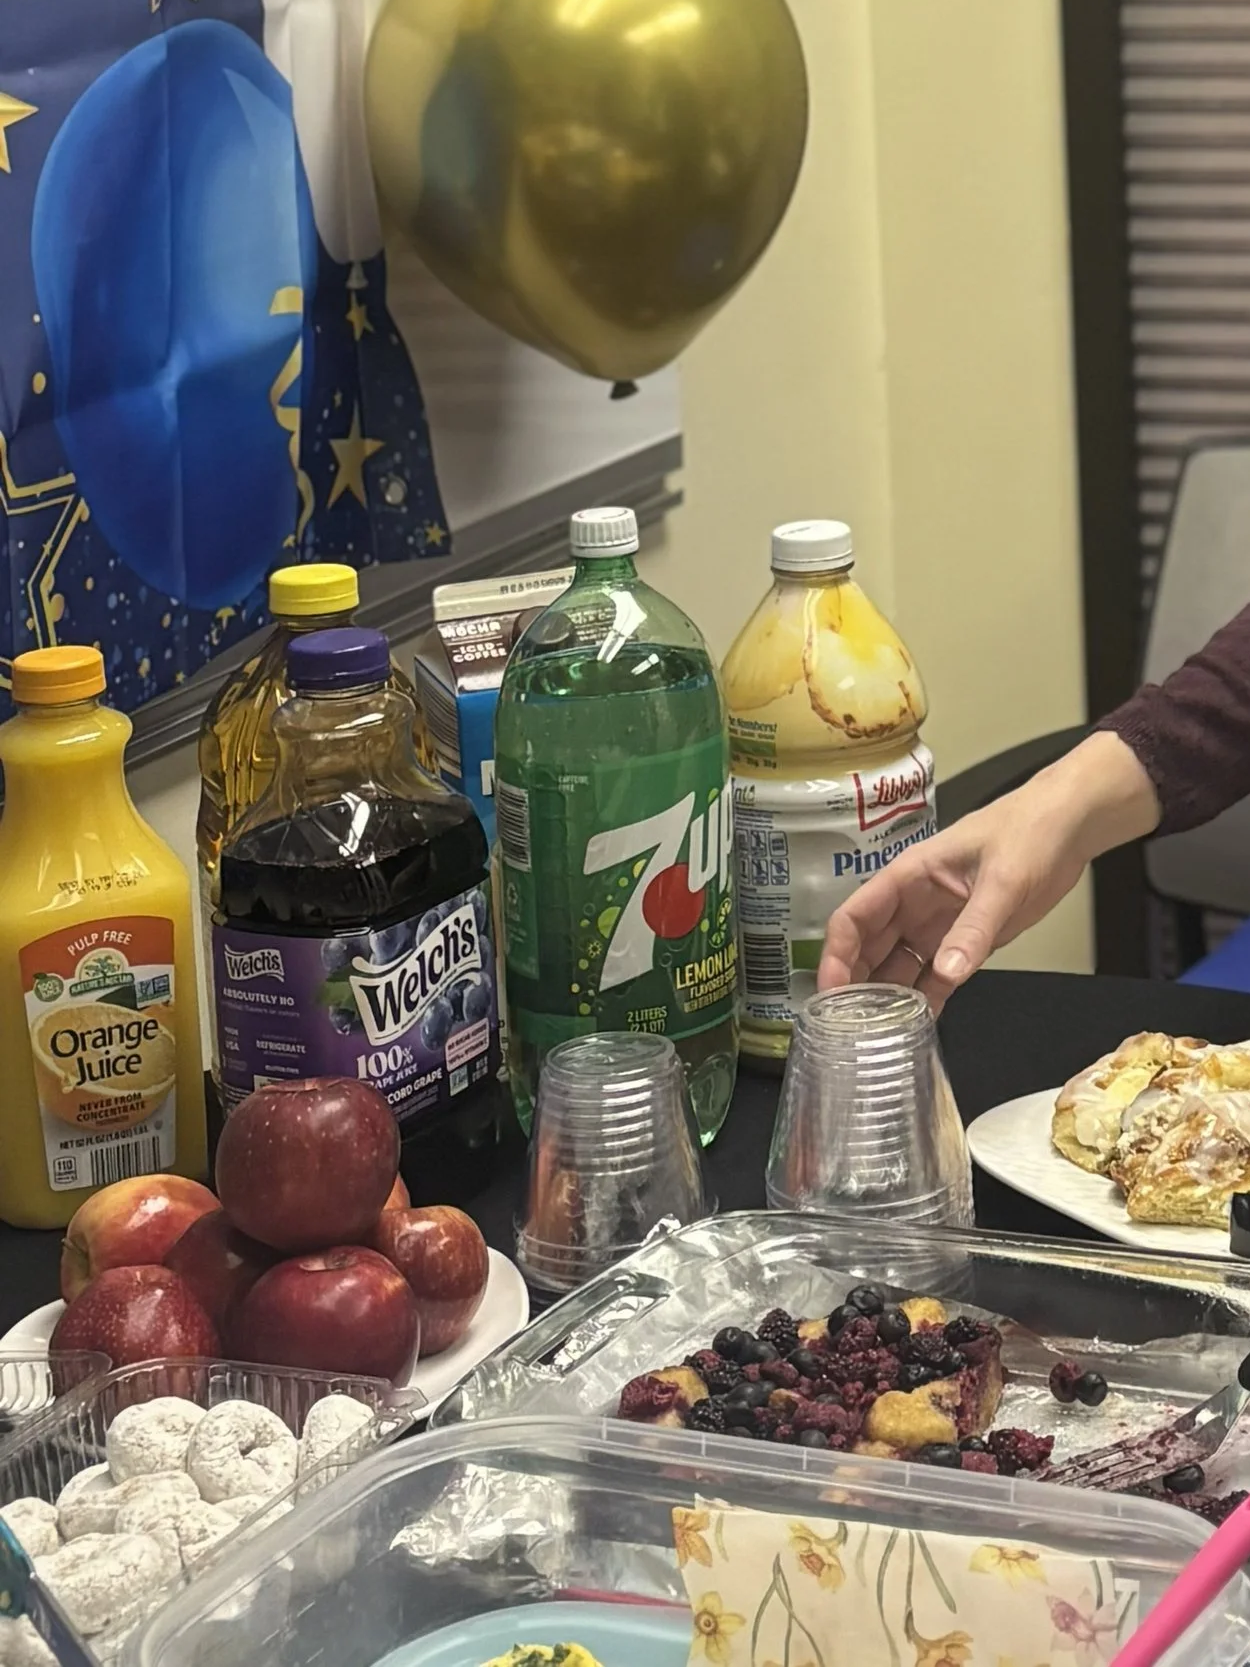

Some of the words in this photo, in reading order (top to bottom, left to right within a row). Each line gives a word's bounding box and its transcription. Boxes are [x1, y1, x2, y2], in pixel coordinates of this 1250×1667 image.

[453, 648, 507, 664] COFFEE
[67, 932, 99, 956] PULP
[102, 930, 133, 945] FREE
[228, 951, 283, 979] Welch's
[359, 916, 477, 1033] Welch's
[676, 951, 723, 990] LEMON
[223, 987, 278, 1005] ABSOLUTELY
[627, 1011, 634, 1023] 2
[635, 1005, 668, 1022] LITERS
[50, 1019, 159, 1058] Orange
[256, 1039, 307, 1055] REFRIGERATE
[76, 1050, 142, 1086] Juice
[356, 1044, 414, 1080] 100%
[385, 1084, 413, 1105] CORD
[413, 1067, 443, 1091] GRAPE
[76, 1101, 146, 1122] CONCENTRATE
[79, 1097, 112, 1112] NEVER
[114, 1092, 142, 1105] FROM
[57, 1160, 73, 1171] 110
